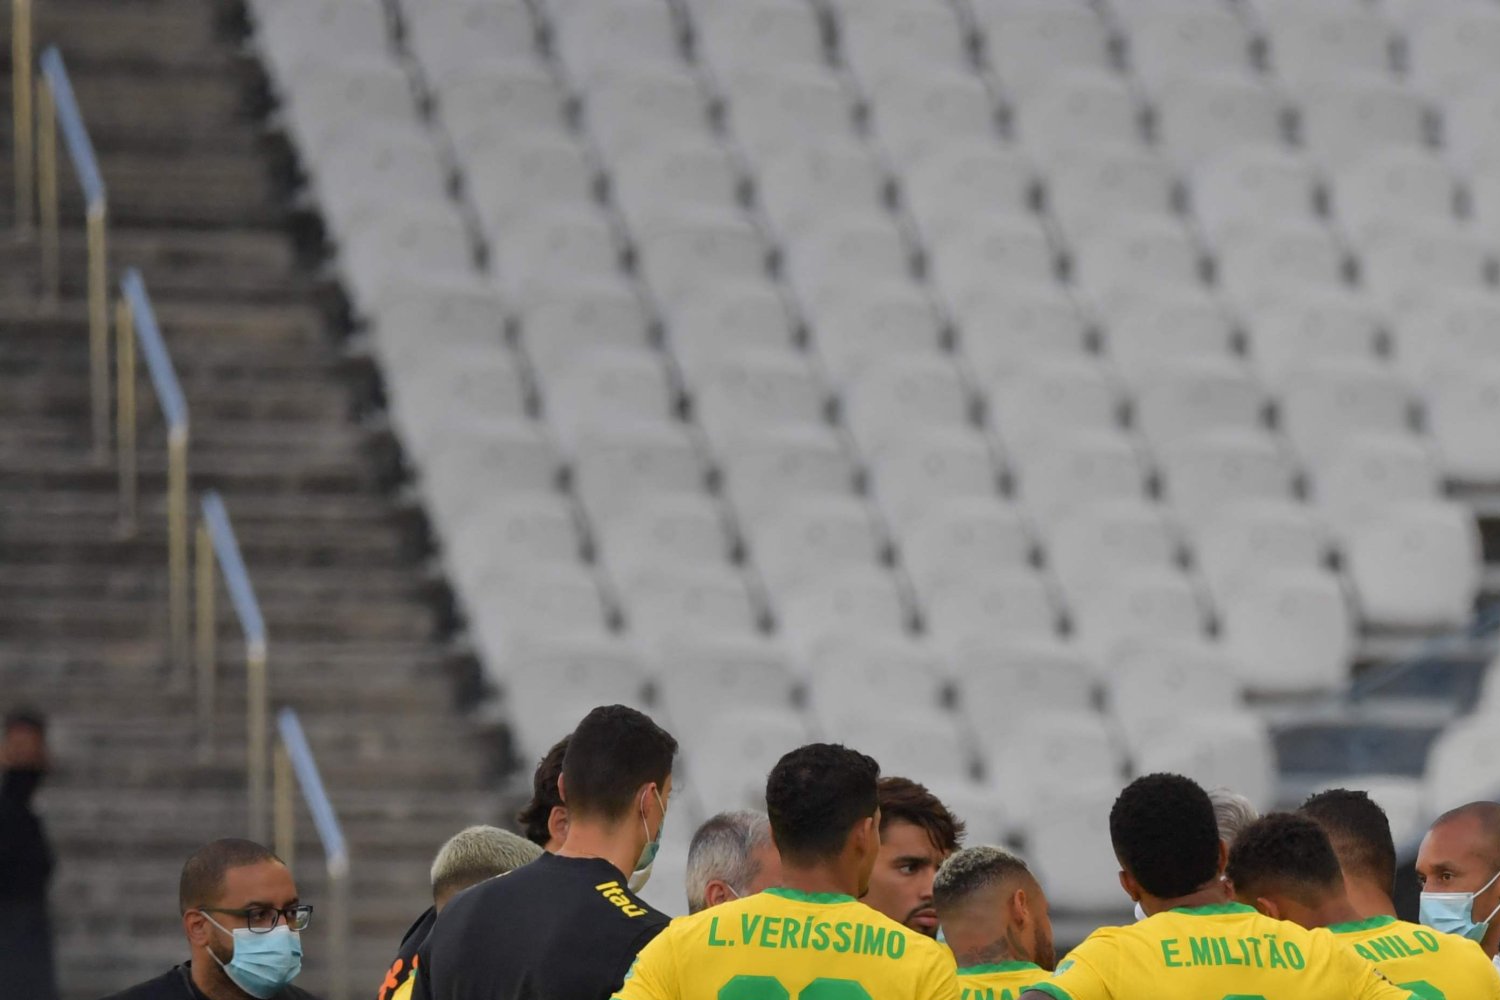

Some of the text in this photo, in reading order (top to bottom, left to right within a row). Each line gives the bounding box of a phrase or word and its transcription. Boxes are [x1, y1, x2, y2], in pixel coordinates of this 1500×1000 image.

[595, 881, 648, 917] Itaú
[708, 912, 906, 960] L.VERÍSSIMO
[1160, 933, 1305, 970] E.MILITÃO
[1353, 930, 1440, 962] ANILO
